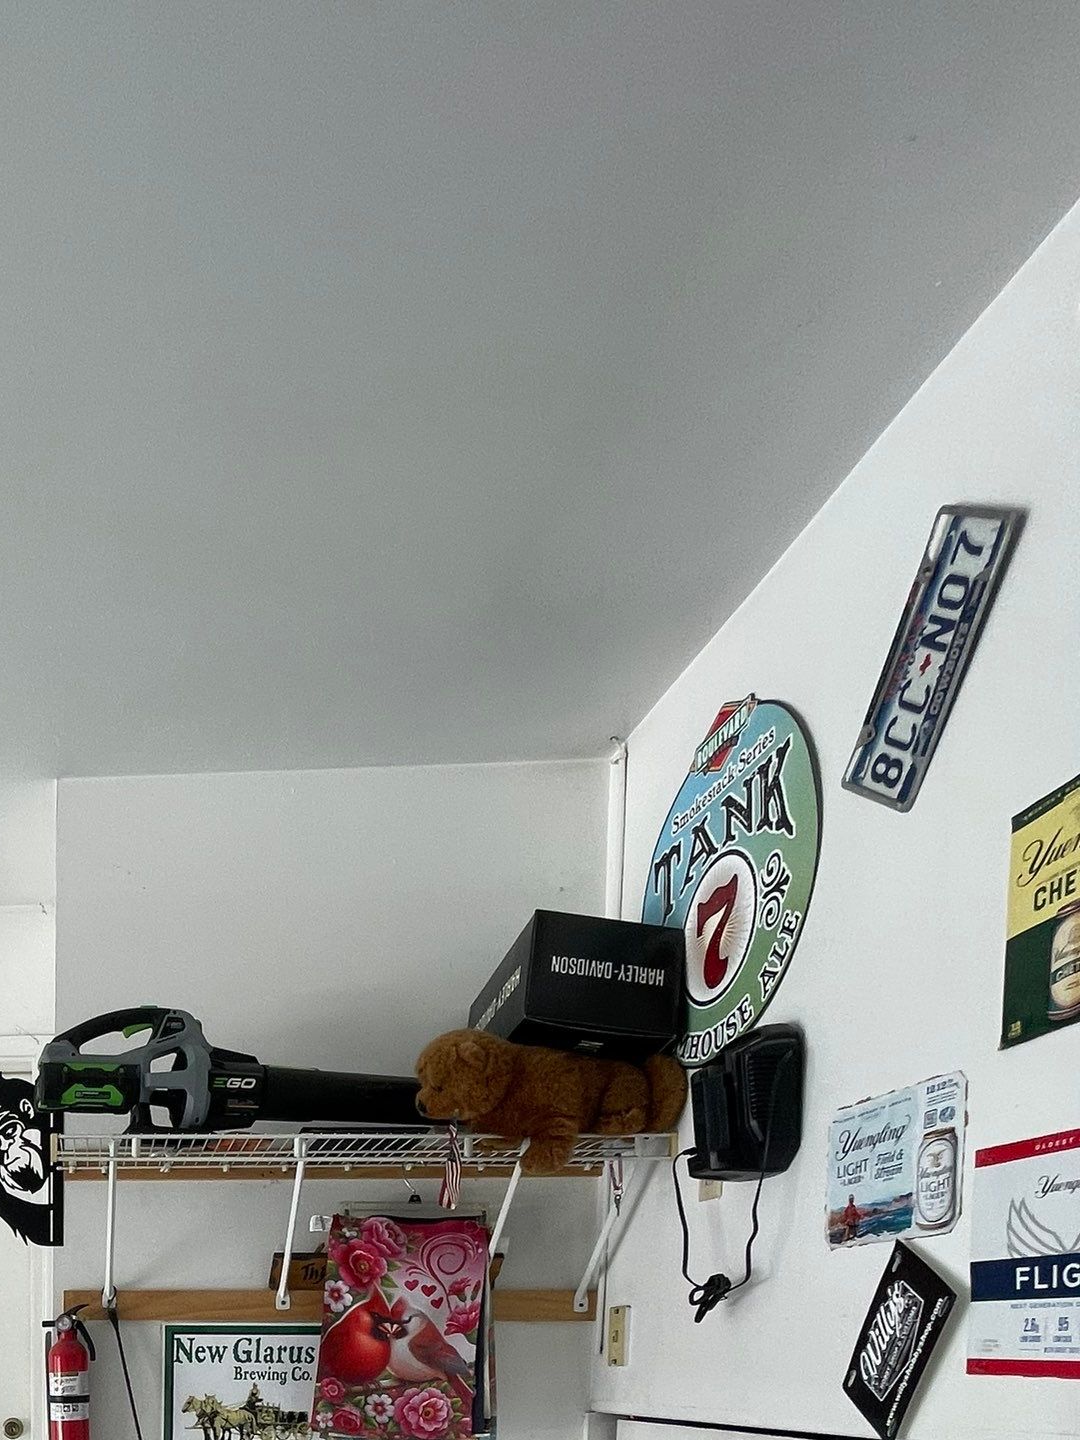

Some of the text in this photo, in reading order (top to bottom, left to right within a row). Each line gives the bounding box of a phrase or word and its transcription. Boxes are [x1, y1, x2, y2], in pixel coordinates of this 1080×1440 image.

[929, 622, 970, 716] COWBOYS
[696, 705, 749, 769] BOULEVARD
[672, 728, 775, 834] Smokestack Series
[653, 737, 794, 925] TANK
[1033, 869, 1078, 912] CHE
[696, 873, 739, 990] 7
[551, 955, 665, 987] HARLEY-DAVIDSON
[759, 912, 800, 1000] ALE
[213, 1077, 257, 1089] EGO
[835, 1113, 912, 1162] Yuengling
[1034, 1136, 1076, 1151] OLDEST
[837, 1157, 870, 1179] LIGHT
[920, 1174, 951, 1193] LIGHT
[174, 1337, 316, 1365] New Glarus
[860, 1280, 905, 1381] Willy's
[233, 1366, 313, 1386] Brewing Co.
